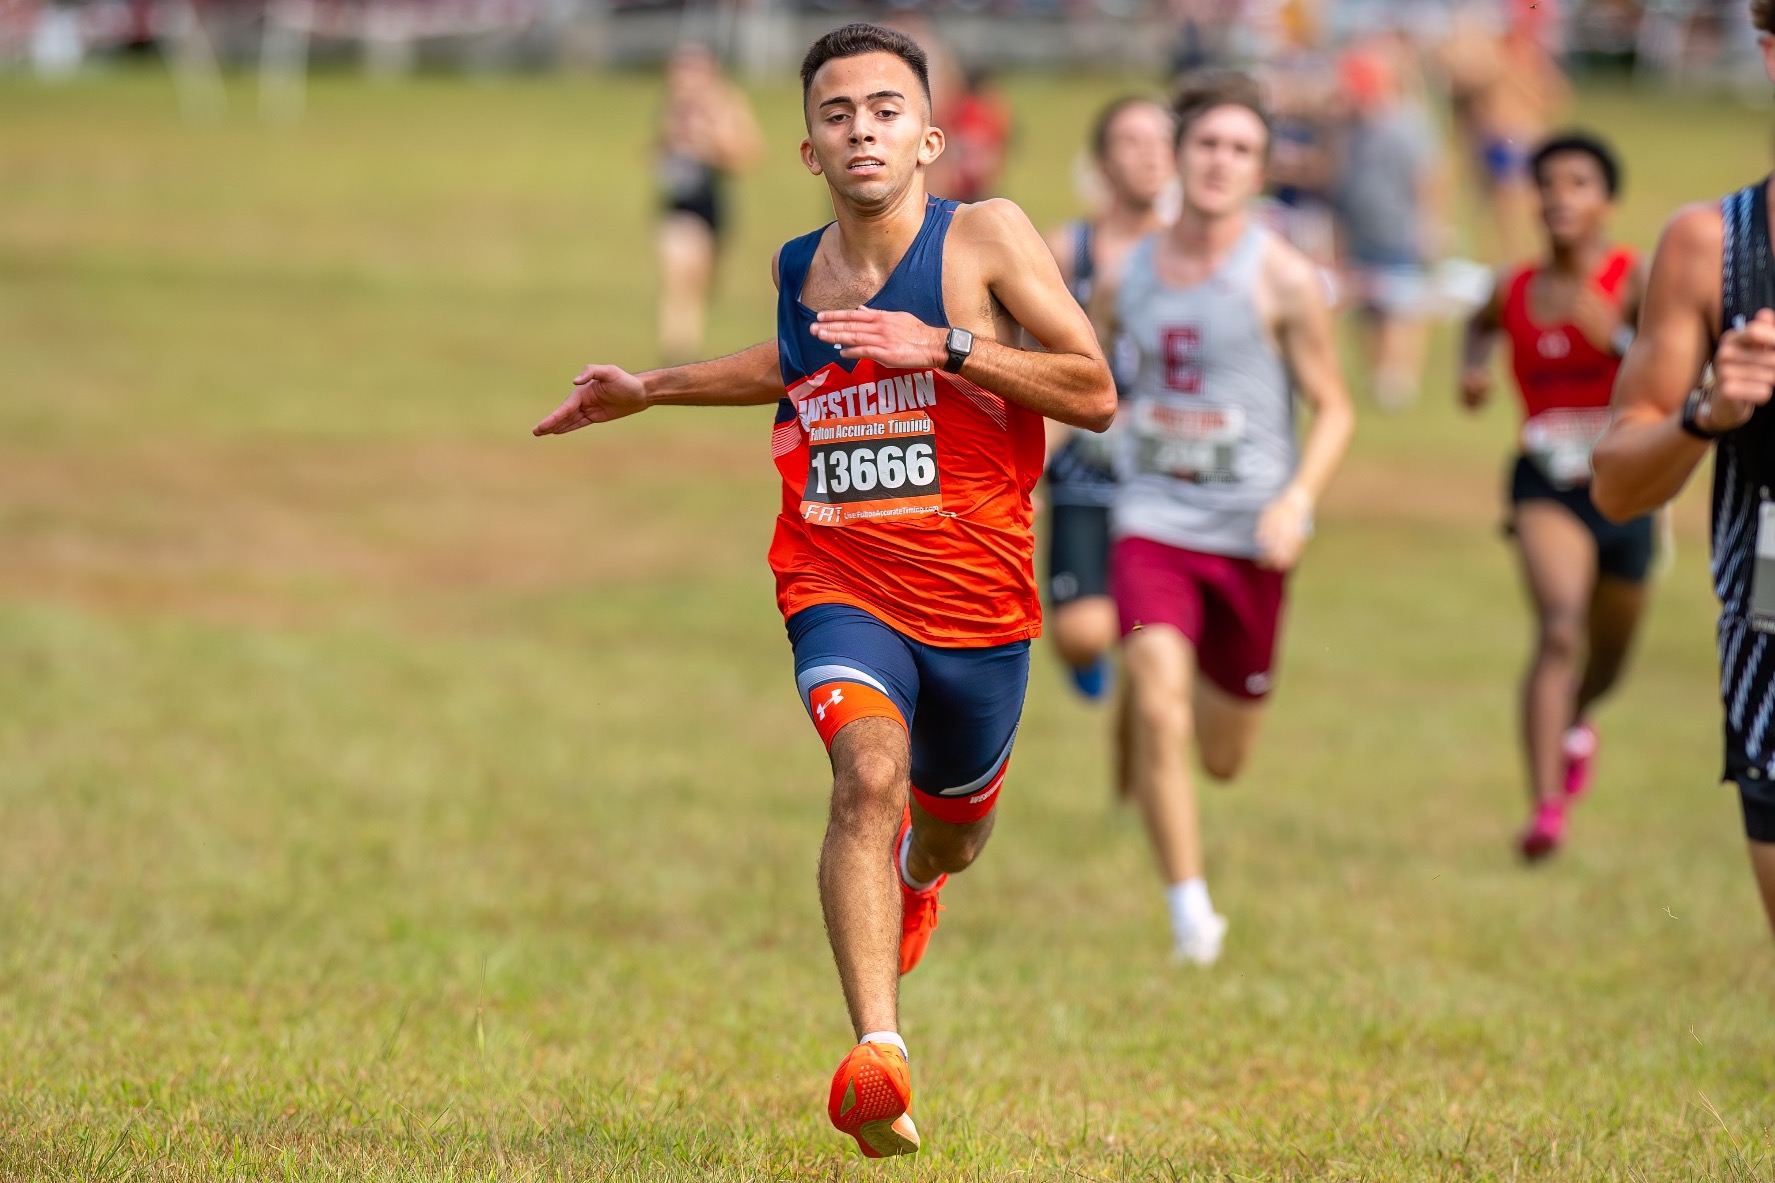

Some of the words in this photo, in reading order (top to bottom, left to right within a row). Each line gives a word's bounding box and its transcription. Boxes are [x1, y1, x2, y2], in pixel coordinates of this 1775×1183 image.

[798, 370, 937, 433] WESTCONN
[810, 427, 835, 442] Fulton
[836, 420, 885, 438] Accurate
[888, 417, 931, 434] Timing
[811, 443, 936, 494] 13666
